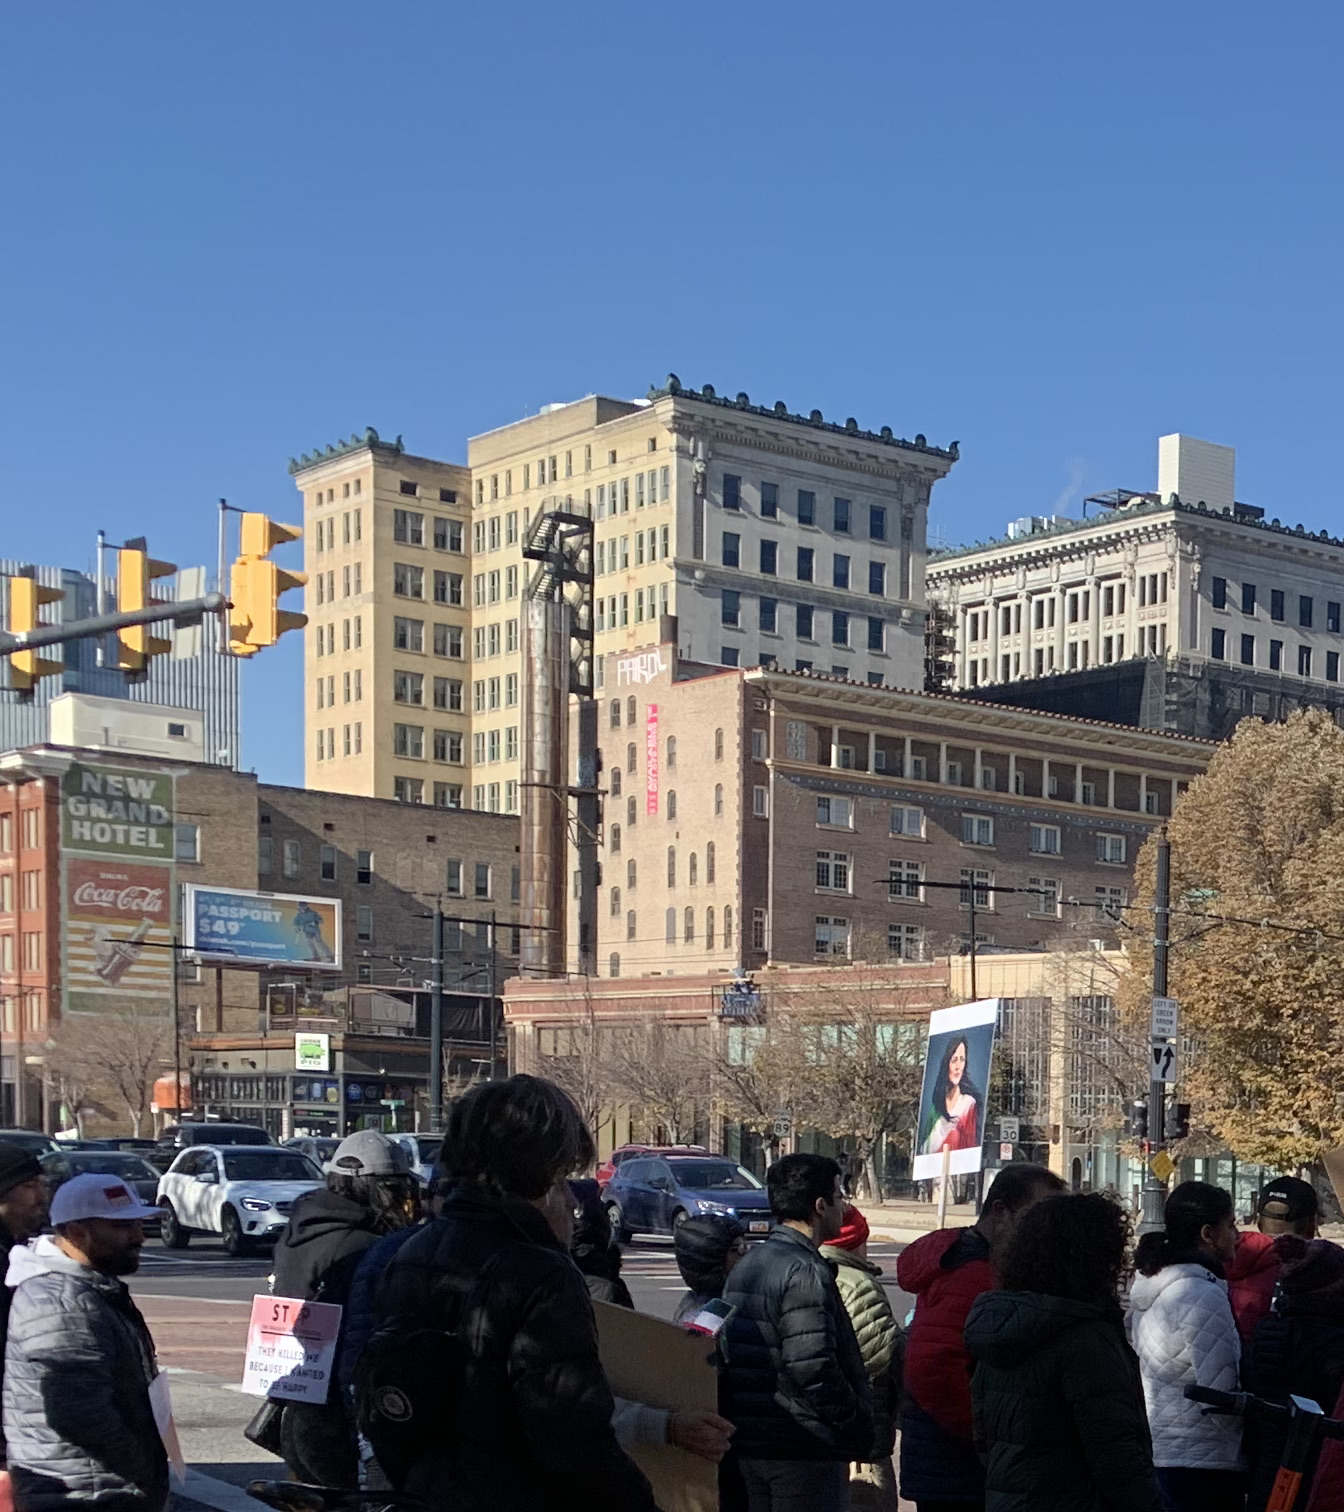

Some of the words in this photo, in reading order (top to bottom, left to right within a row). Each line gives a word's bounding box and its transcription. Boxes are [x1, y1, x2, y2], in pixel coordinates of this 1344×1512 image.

[80, 771, 156, 800] NEW
[67, 796, 170, 825] GRAND
[71, 820, 164, 848] HOTEL
[74, 882, 165, 913] Coca-Cola
[198, 904, 283, 923] PASSPORT
[775, 1123, 789, 1133] 89
[1003, 1131, 1016, 1140] 30
[258, 1346, 276, 1357] THEY
[278, 1348, 305, 1361] KILLED
[249, 1361, 283, 1374] BECAUSE
[290, 1367, 325, 1380] WANTED
[259, 1379, 269, 1389] TO
